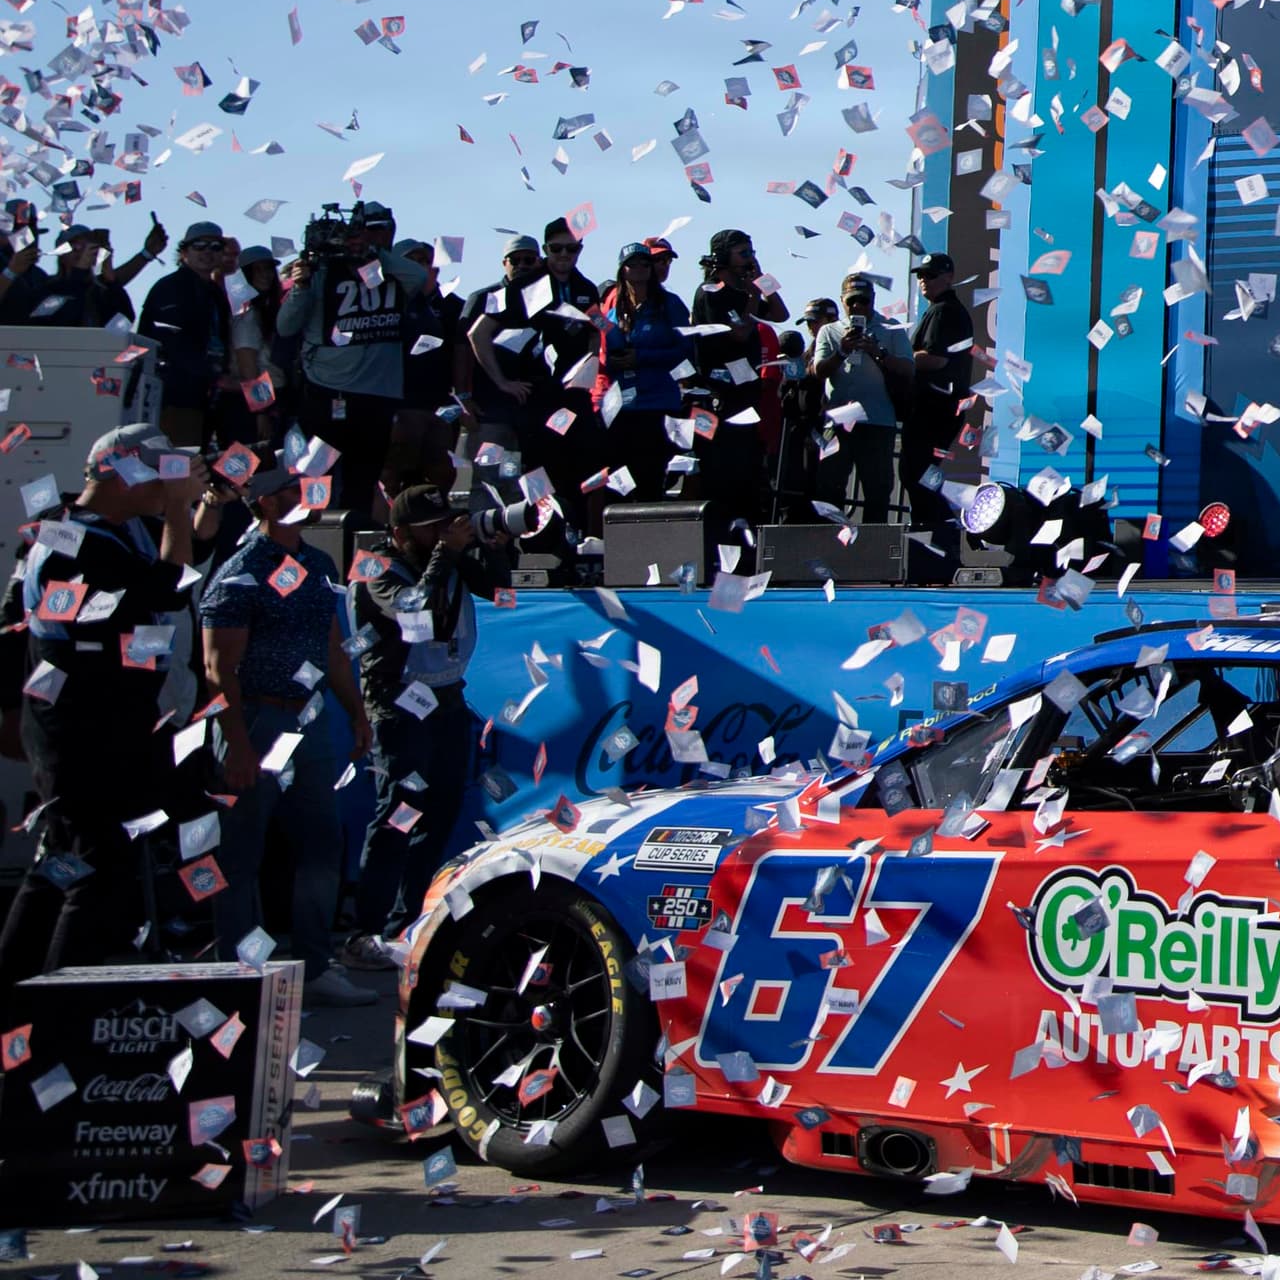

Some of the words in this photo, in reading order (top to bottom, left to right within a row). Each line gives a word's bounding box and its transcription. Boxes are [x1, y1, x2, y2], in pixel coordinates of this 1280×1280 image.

[671, 830, 720, 844] NASCAR
[648, 847, 670, 860] CUP
[670, 848, 709, 862] SERIES
[663, 899, 699, 916] 250
[590, 921, 624, 1015] EAGLE
[696, 849, 1004, 1077] 67
[92, 1017, 178, 1044] BUSCH
[270, 976, 288, 1081] SERIES
[1036, 1009, 1148, 1069] AUTO
[109, 1041, 160, 1054] LIGHT
[82, 1072, 171, 1102] Coca-Cola
[75, 1121, 177, 1145] Freeway
[73, 1146, 175, 1158] INSURANCE
[67, 1172, 168, 1204] xfinity
